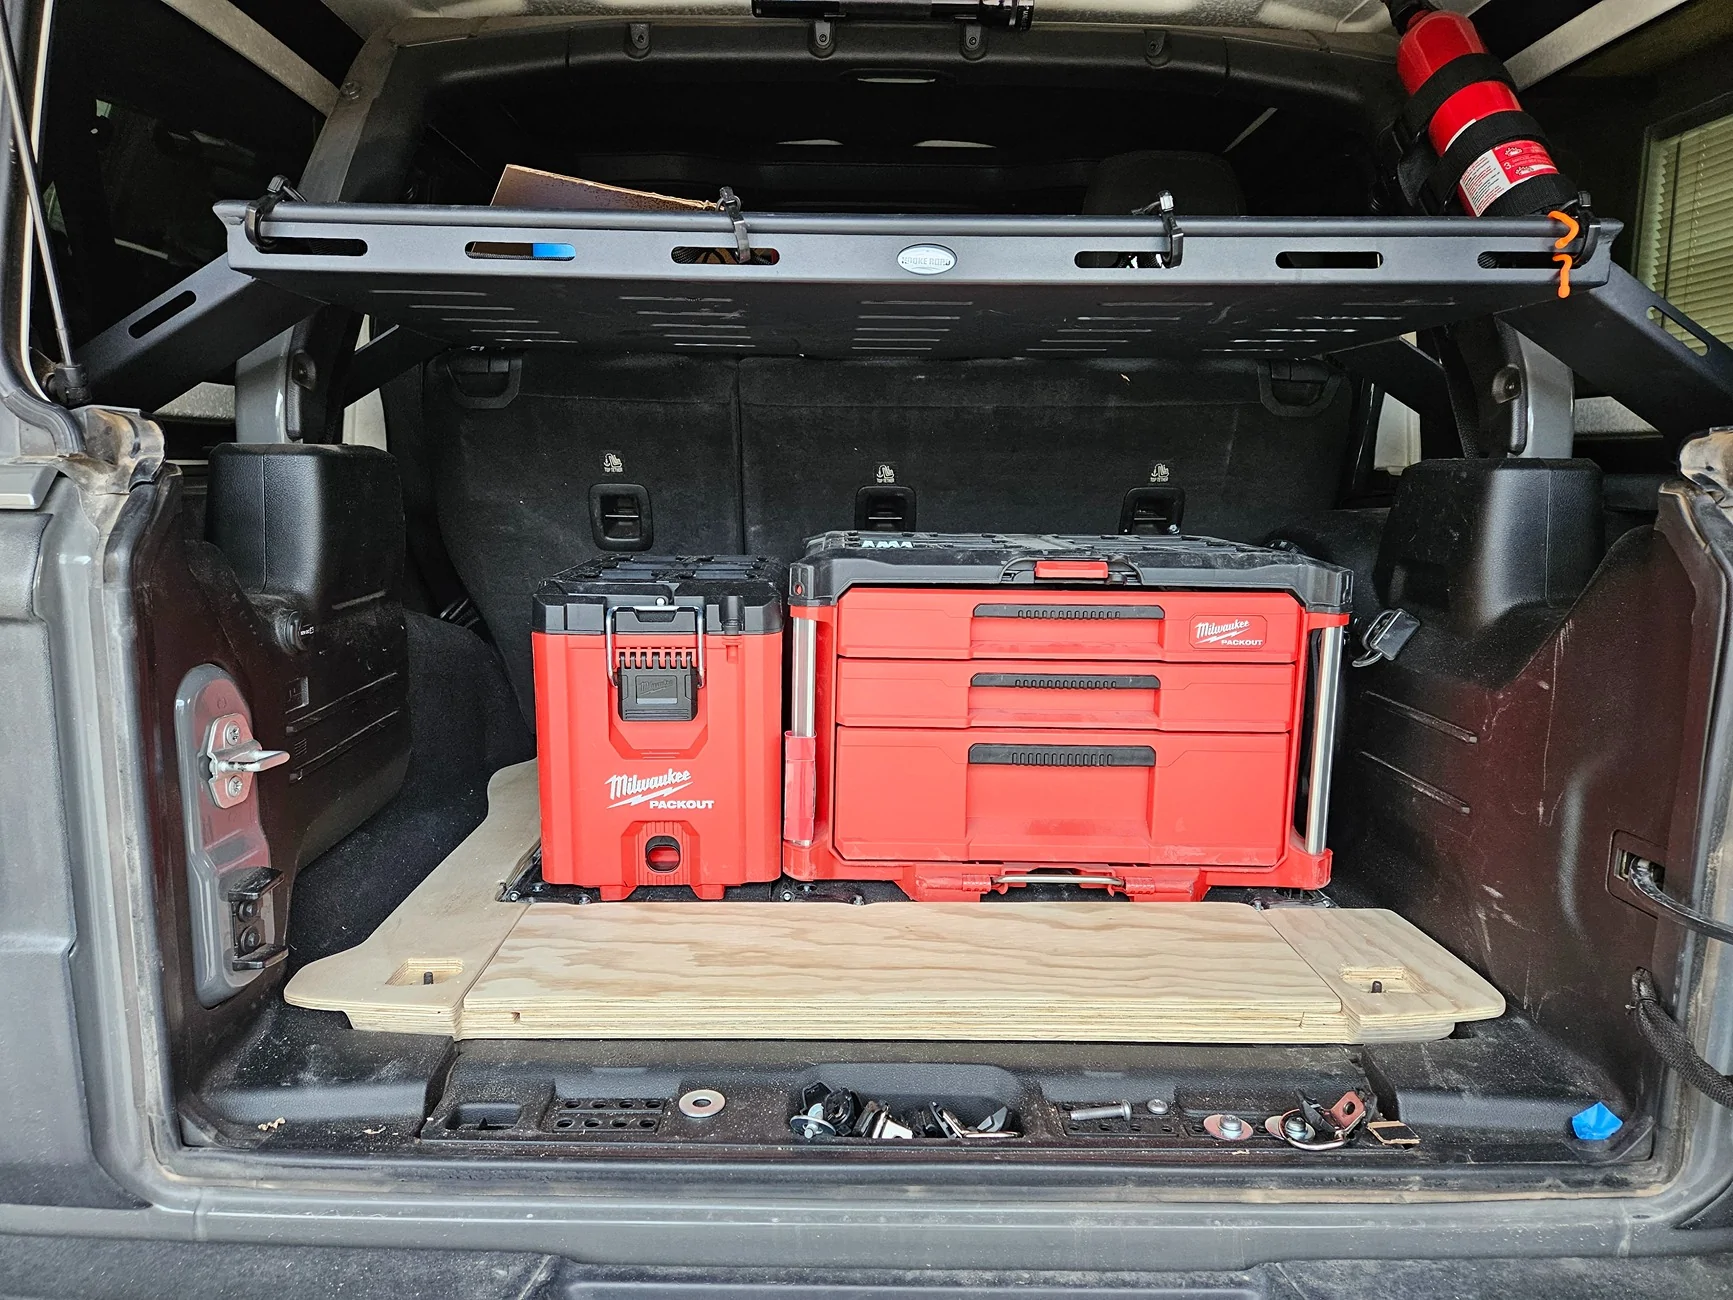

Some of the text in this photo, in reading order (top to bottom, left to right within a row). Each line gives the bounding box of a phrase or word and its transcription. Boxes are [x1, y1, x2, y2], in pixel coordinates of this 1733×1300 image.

[1194, 619, 1251, 639] Milwaukee
[604, 768, 692, 800] Milwaukee
[649, 800, 715, 809] PACKOUT
